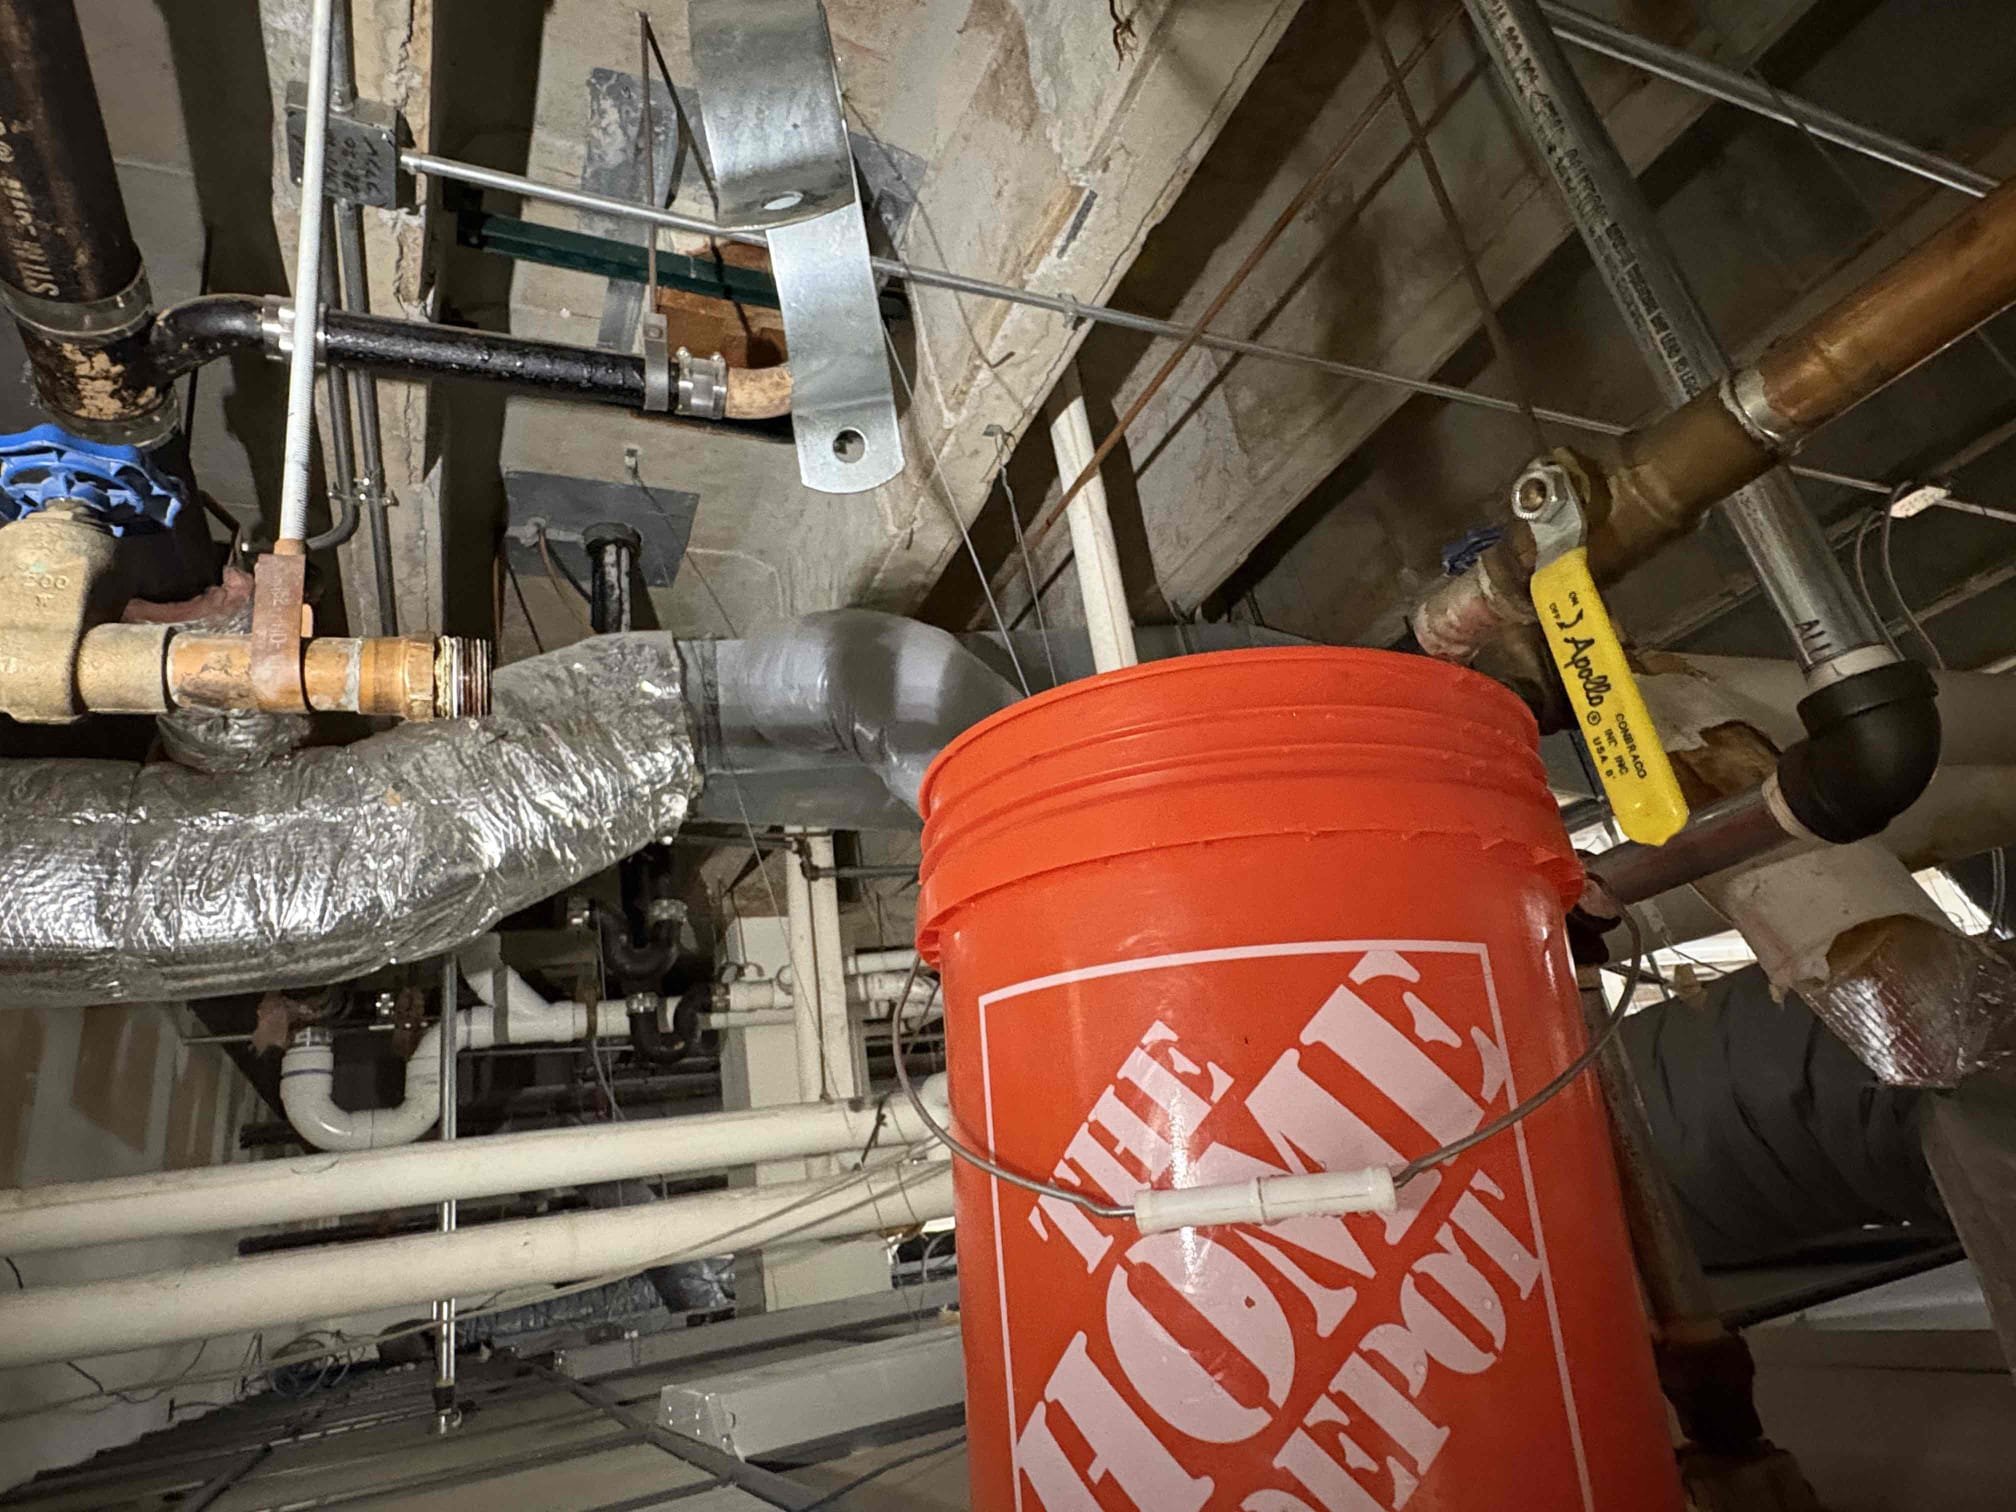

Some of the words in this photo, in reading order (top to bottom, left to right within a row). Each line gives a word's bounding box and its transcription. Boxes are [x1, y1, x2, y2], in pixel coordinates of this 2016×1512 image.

[1568, 591, 1580, 607] ON
[1563, 636, 1611, 708] Apollo
[1592, 736, 1608, 765] USA
[1615, 712, 1648, 779] CONBRACO
[1027, 1019, 1235, 1274] THE
[1014, 949, 1506, 1512] HOME
[1240, 1170, 1543, 1512] EPOT
